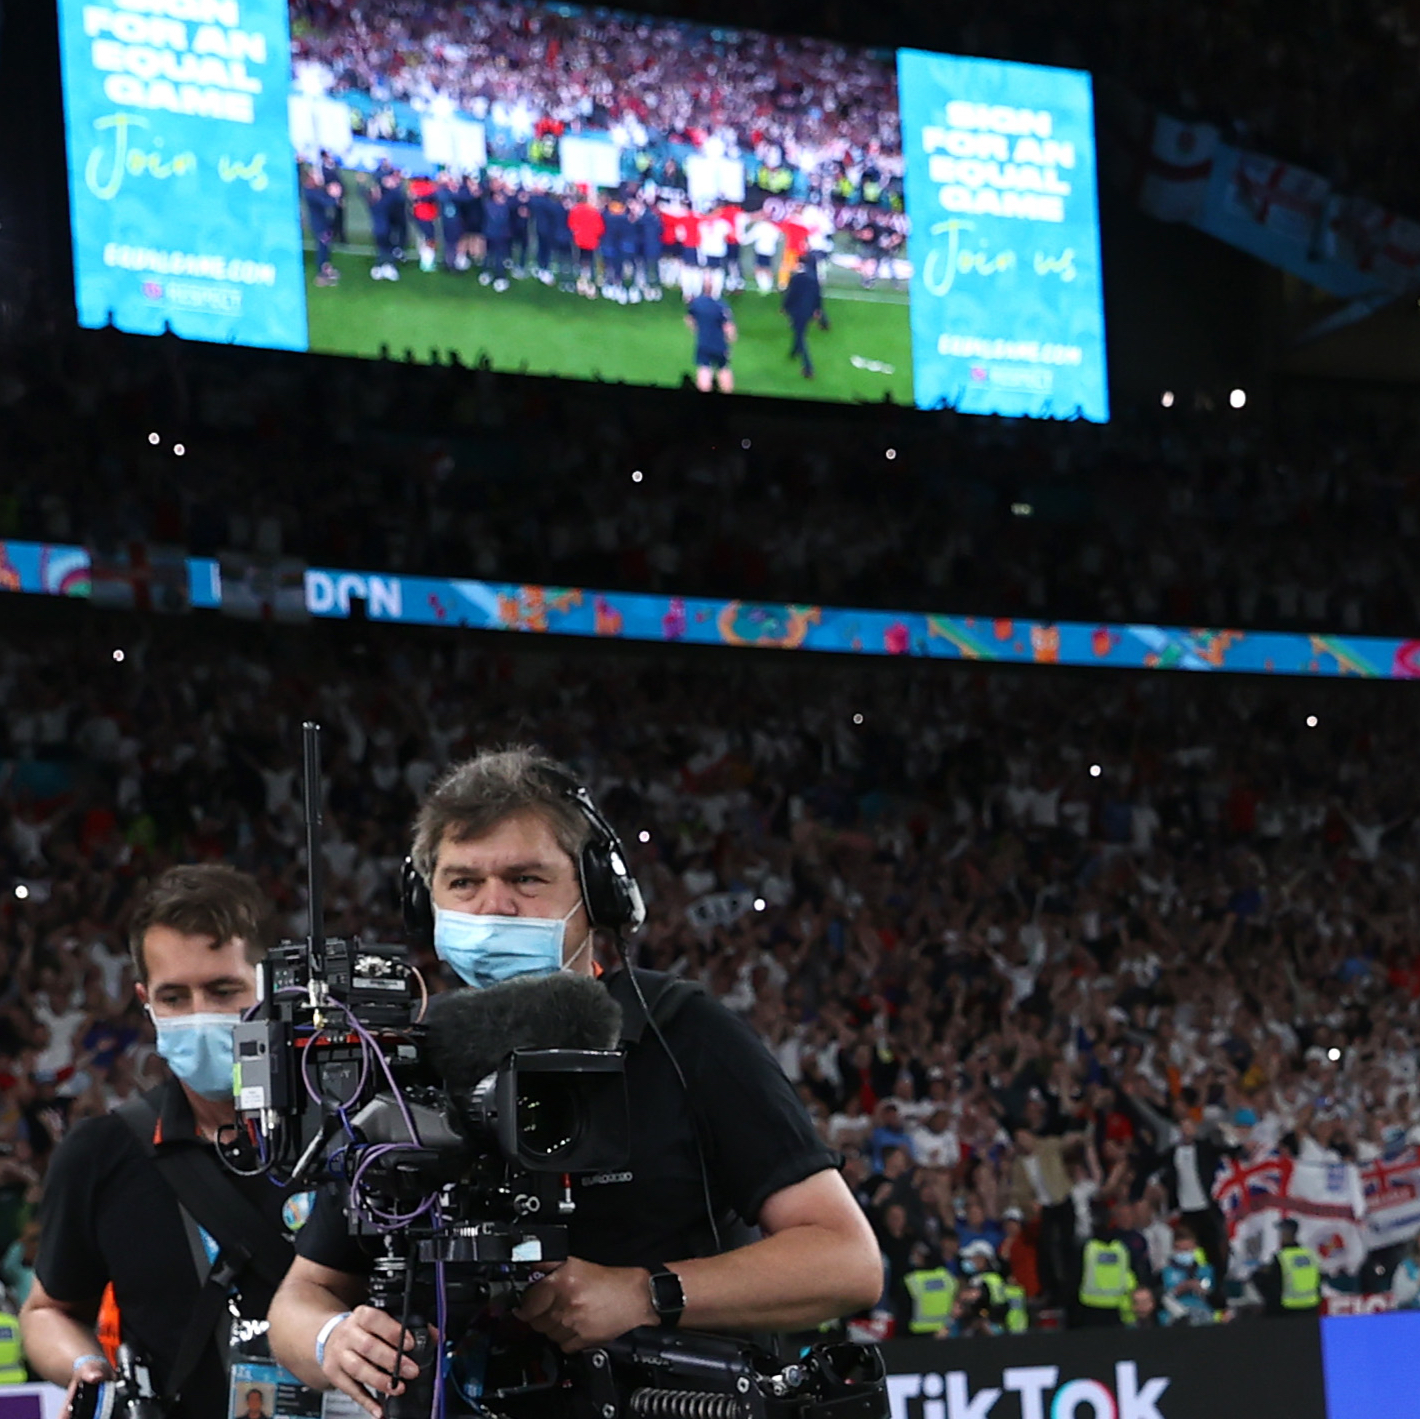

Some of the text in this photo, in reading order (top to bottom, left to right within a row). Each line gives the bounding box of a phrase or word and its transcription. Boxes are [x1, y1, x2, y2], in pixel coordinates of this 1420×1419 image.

[92, 39, 262, 94] EQUAL
[85, 113, 269, 200] Join us
[929, 154, 1072, 196] EQUAL
[923, 218, 1077, 296] Join us
